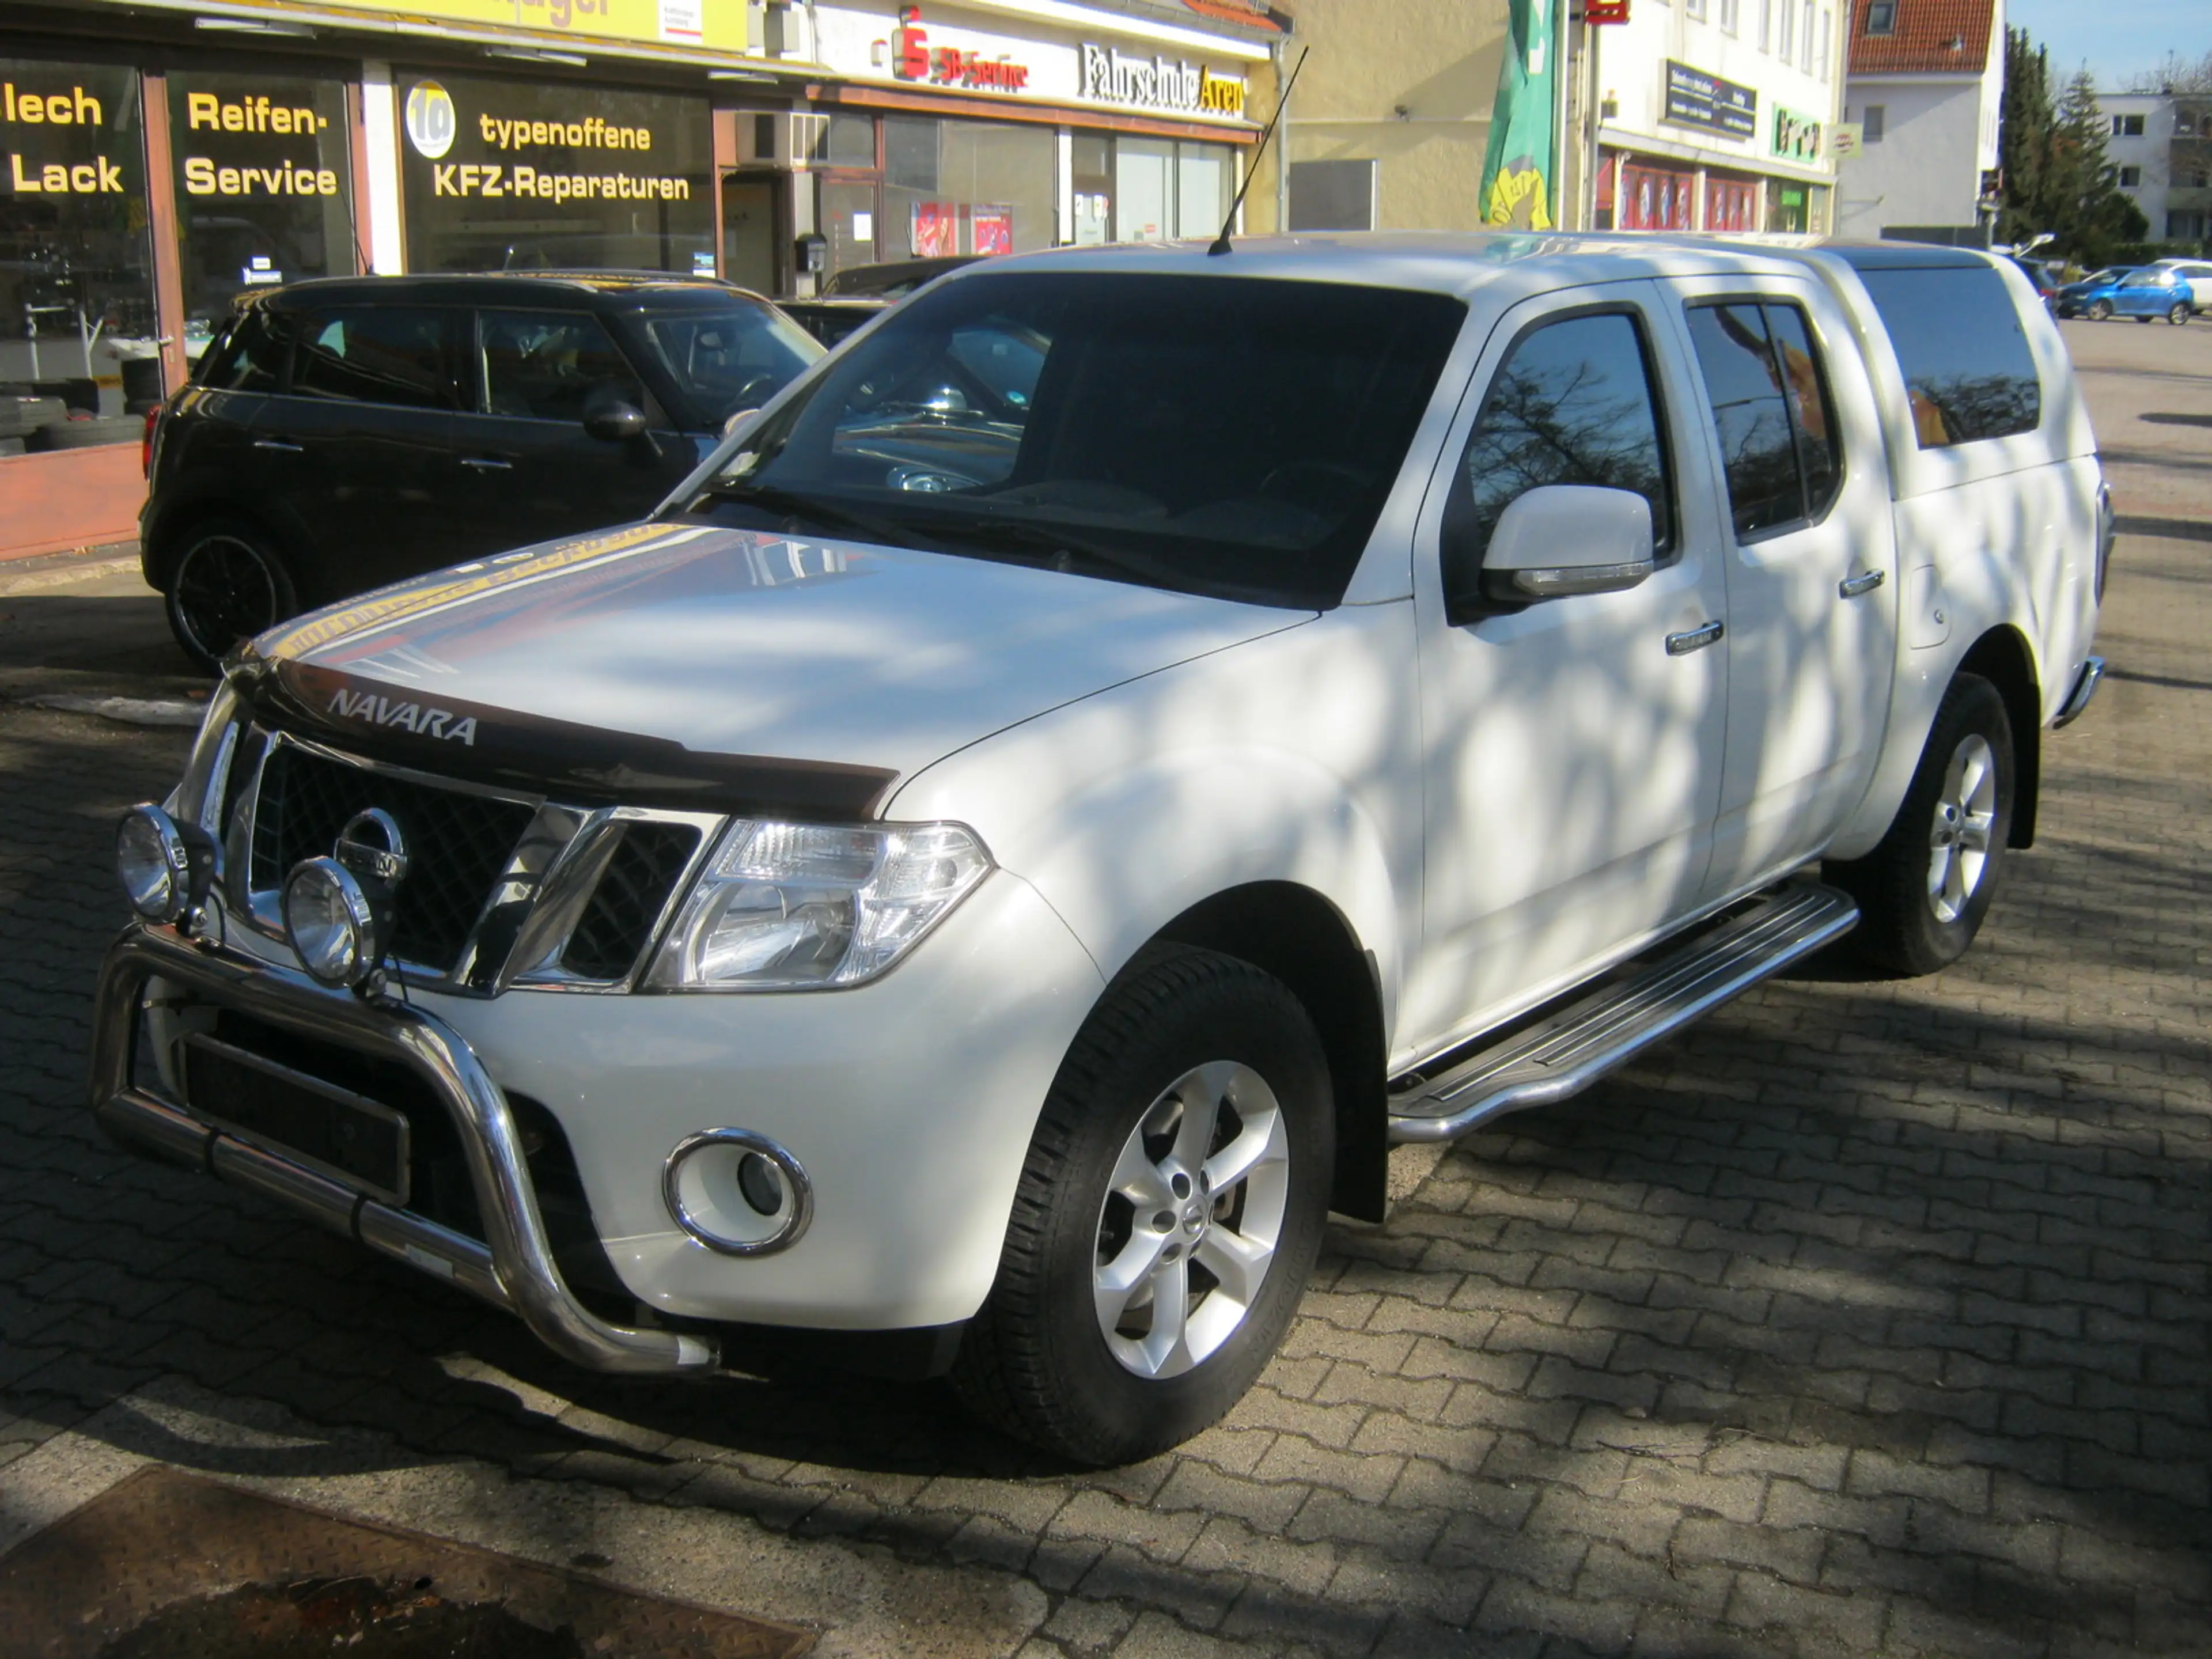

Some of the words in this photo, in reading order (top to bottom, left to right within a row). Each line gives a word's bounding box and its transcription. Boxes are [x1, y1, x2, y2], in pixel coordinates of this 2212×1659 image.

[1081, 43, 1200, 108] Fahrschule
[0, 83, 103, 126] lech
[188, 92, 328, 134] Reifen-
[479, 113, 652, 150] typenoffene
[11, 154, 124, 192] Lack
[185, 157, 338, 196] Service
[433, 163, 690, 204] KFZ-Reparaturen
[327, 688, 478, 747] NAVARA
